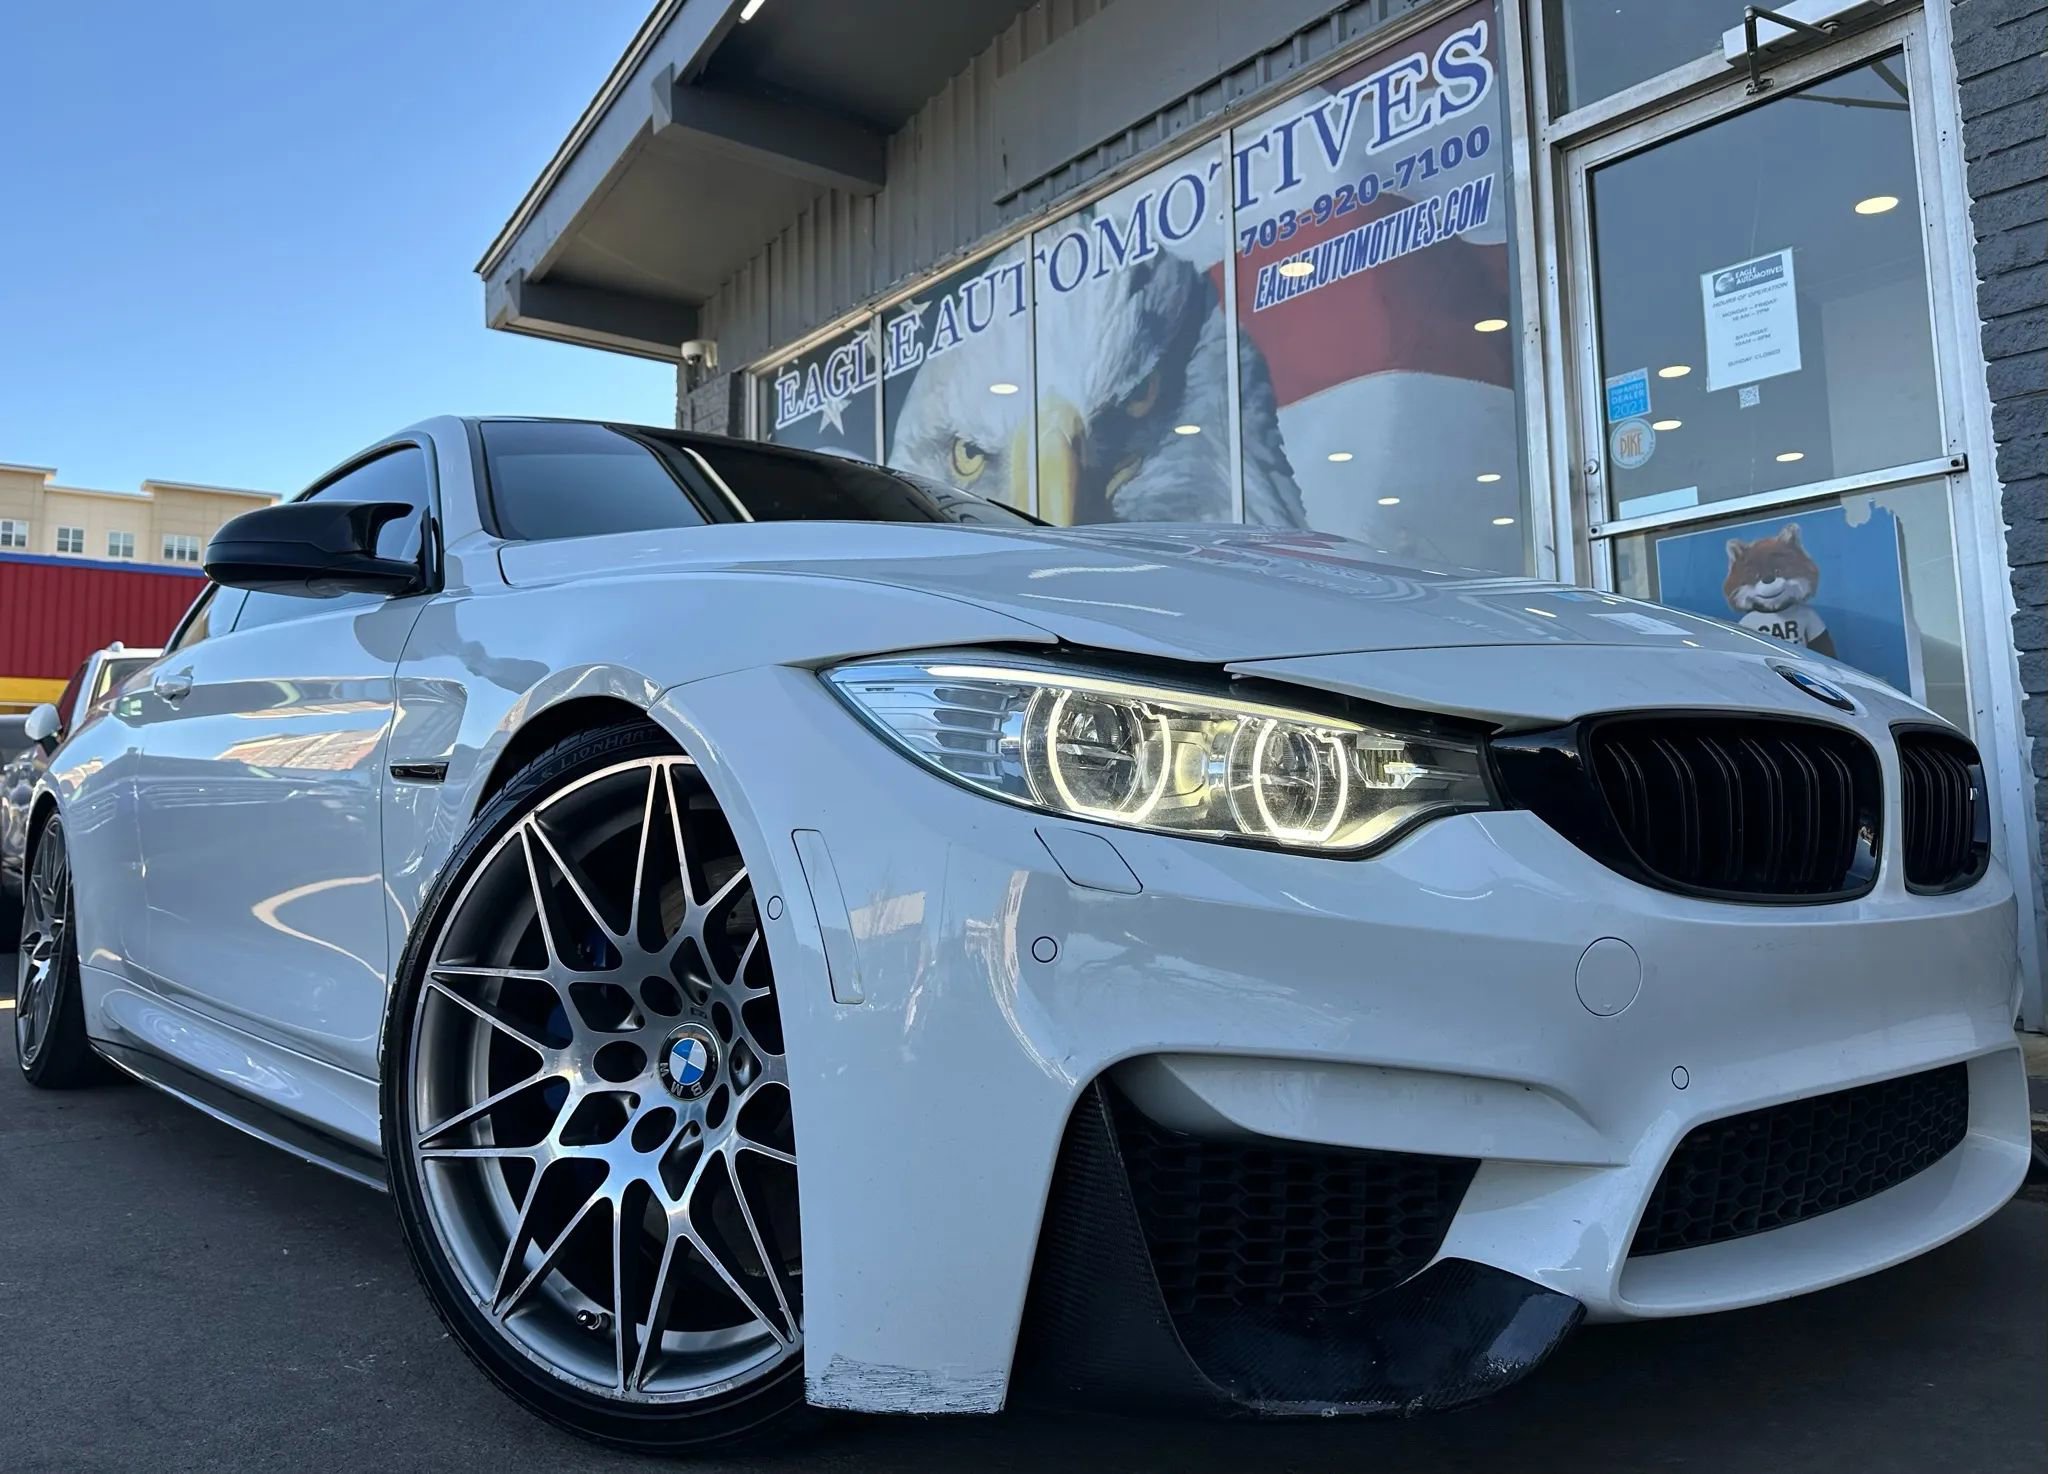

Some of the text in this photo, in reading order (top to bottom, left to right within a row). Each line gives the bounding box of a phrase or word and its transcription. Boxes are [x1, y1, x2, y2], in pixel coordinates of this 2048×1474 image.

[1240, 124, 1492, 257] 703-920-7100
[775, 20, 1495, 430] EAGLE AUTOMOTIVES
[1253, 173, 1495, 312] EAGLEAUTOMOTIVES.COM
[1735, 266, 1757, 279] EAGLE
[1736, 265, 1785, 285] AUTOMOTIVES
[1747, 281, 1789, 298] OPERATION
[1611, 389, 1645, 405] DEALER
[1612, 398, 1645, 418] 2021
[660, 1061, 704, 1097] BMW
